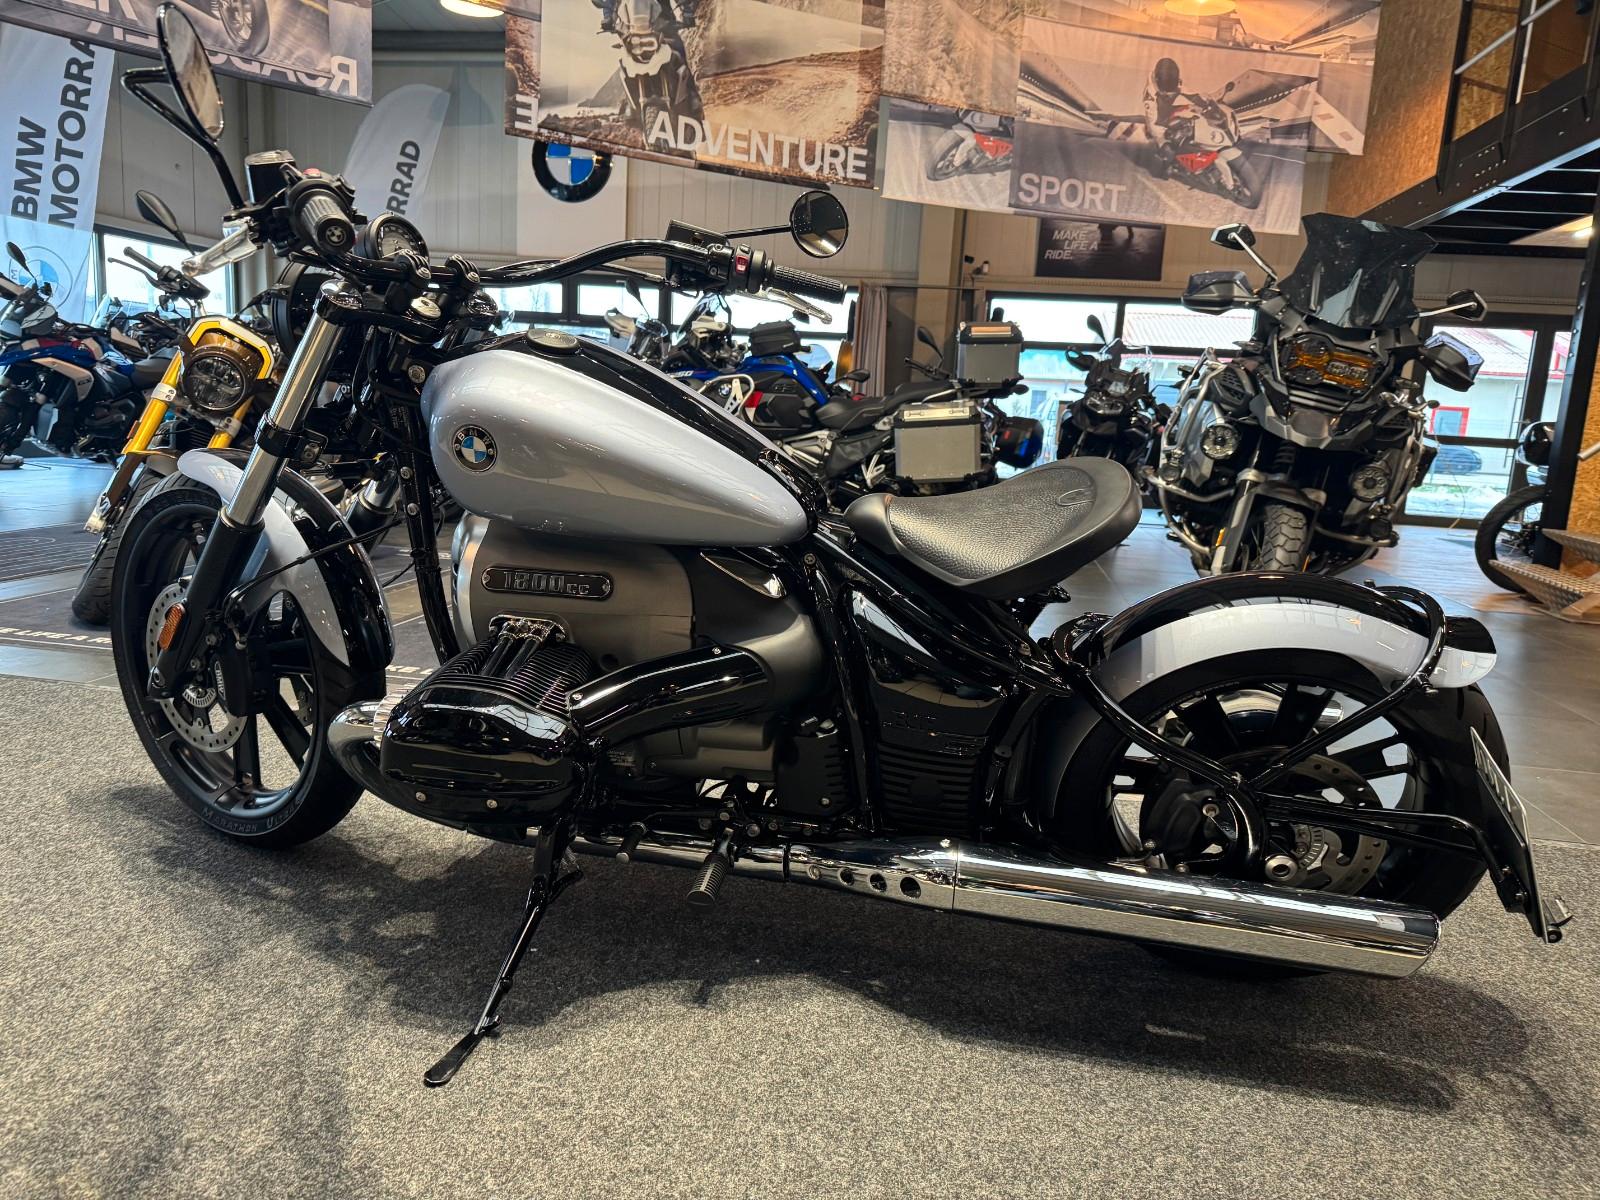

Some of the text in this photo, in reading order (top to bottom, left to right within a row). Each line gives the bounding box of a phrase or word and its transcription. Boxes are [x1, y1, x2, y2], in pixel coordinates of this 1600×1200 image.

[648, 111, 868, 181] ADVENTURE
[11, 116, 46, 221] BMW
[1018, 173, 1127, 212] SPORT
[1052, 230, 1088, 241] MAKE
[1064, 240, 1098, 250] LIFE A
[1044, 250, 1073, 260] RIDE.
[457, 428, 492, 446] BMW
